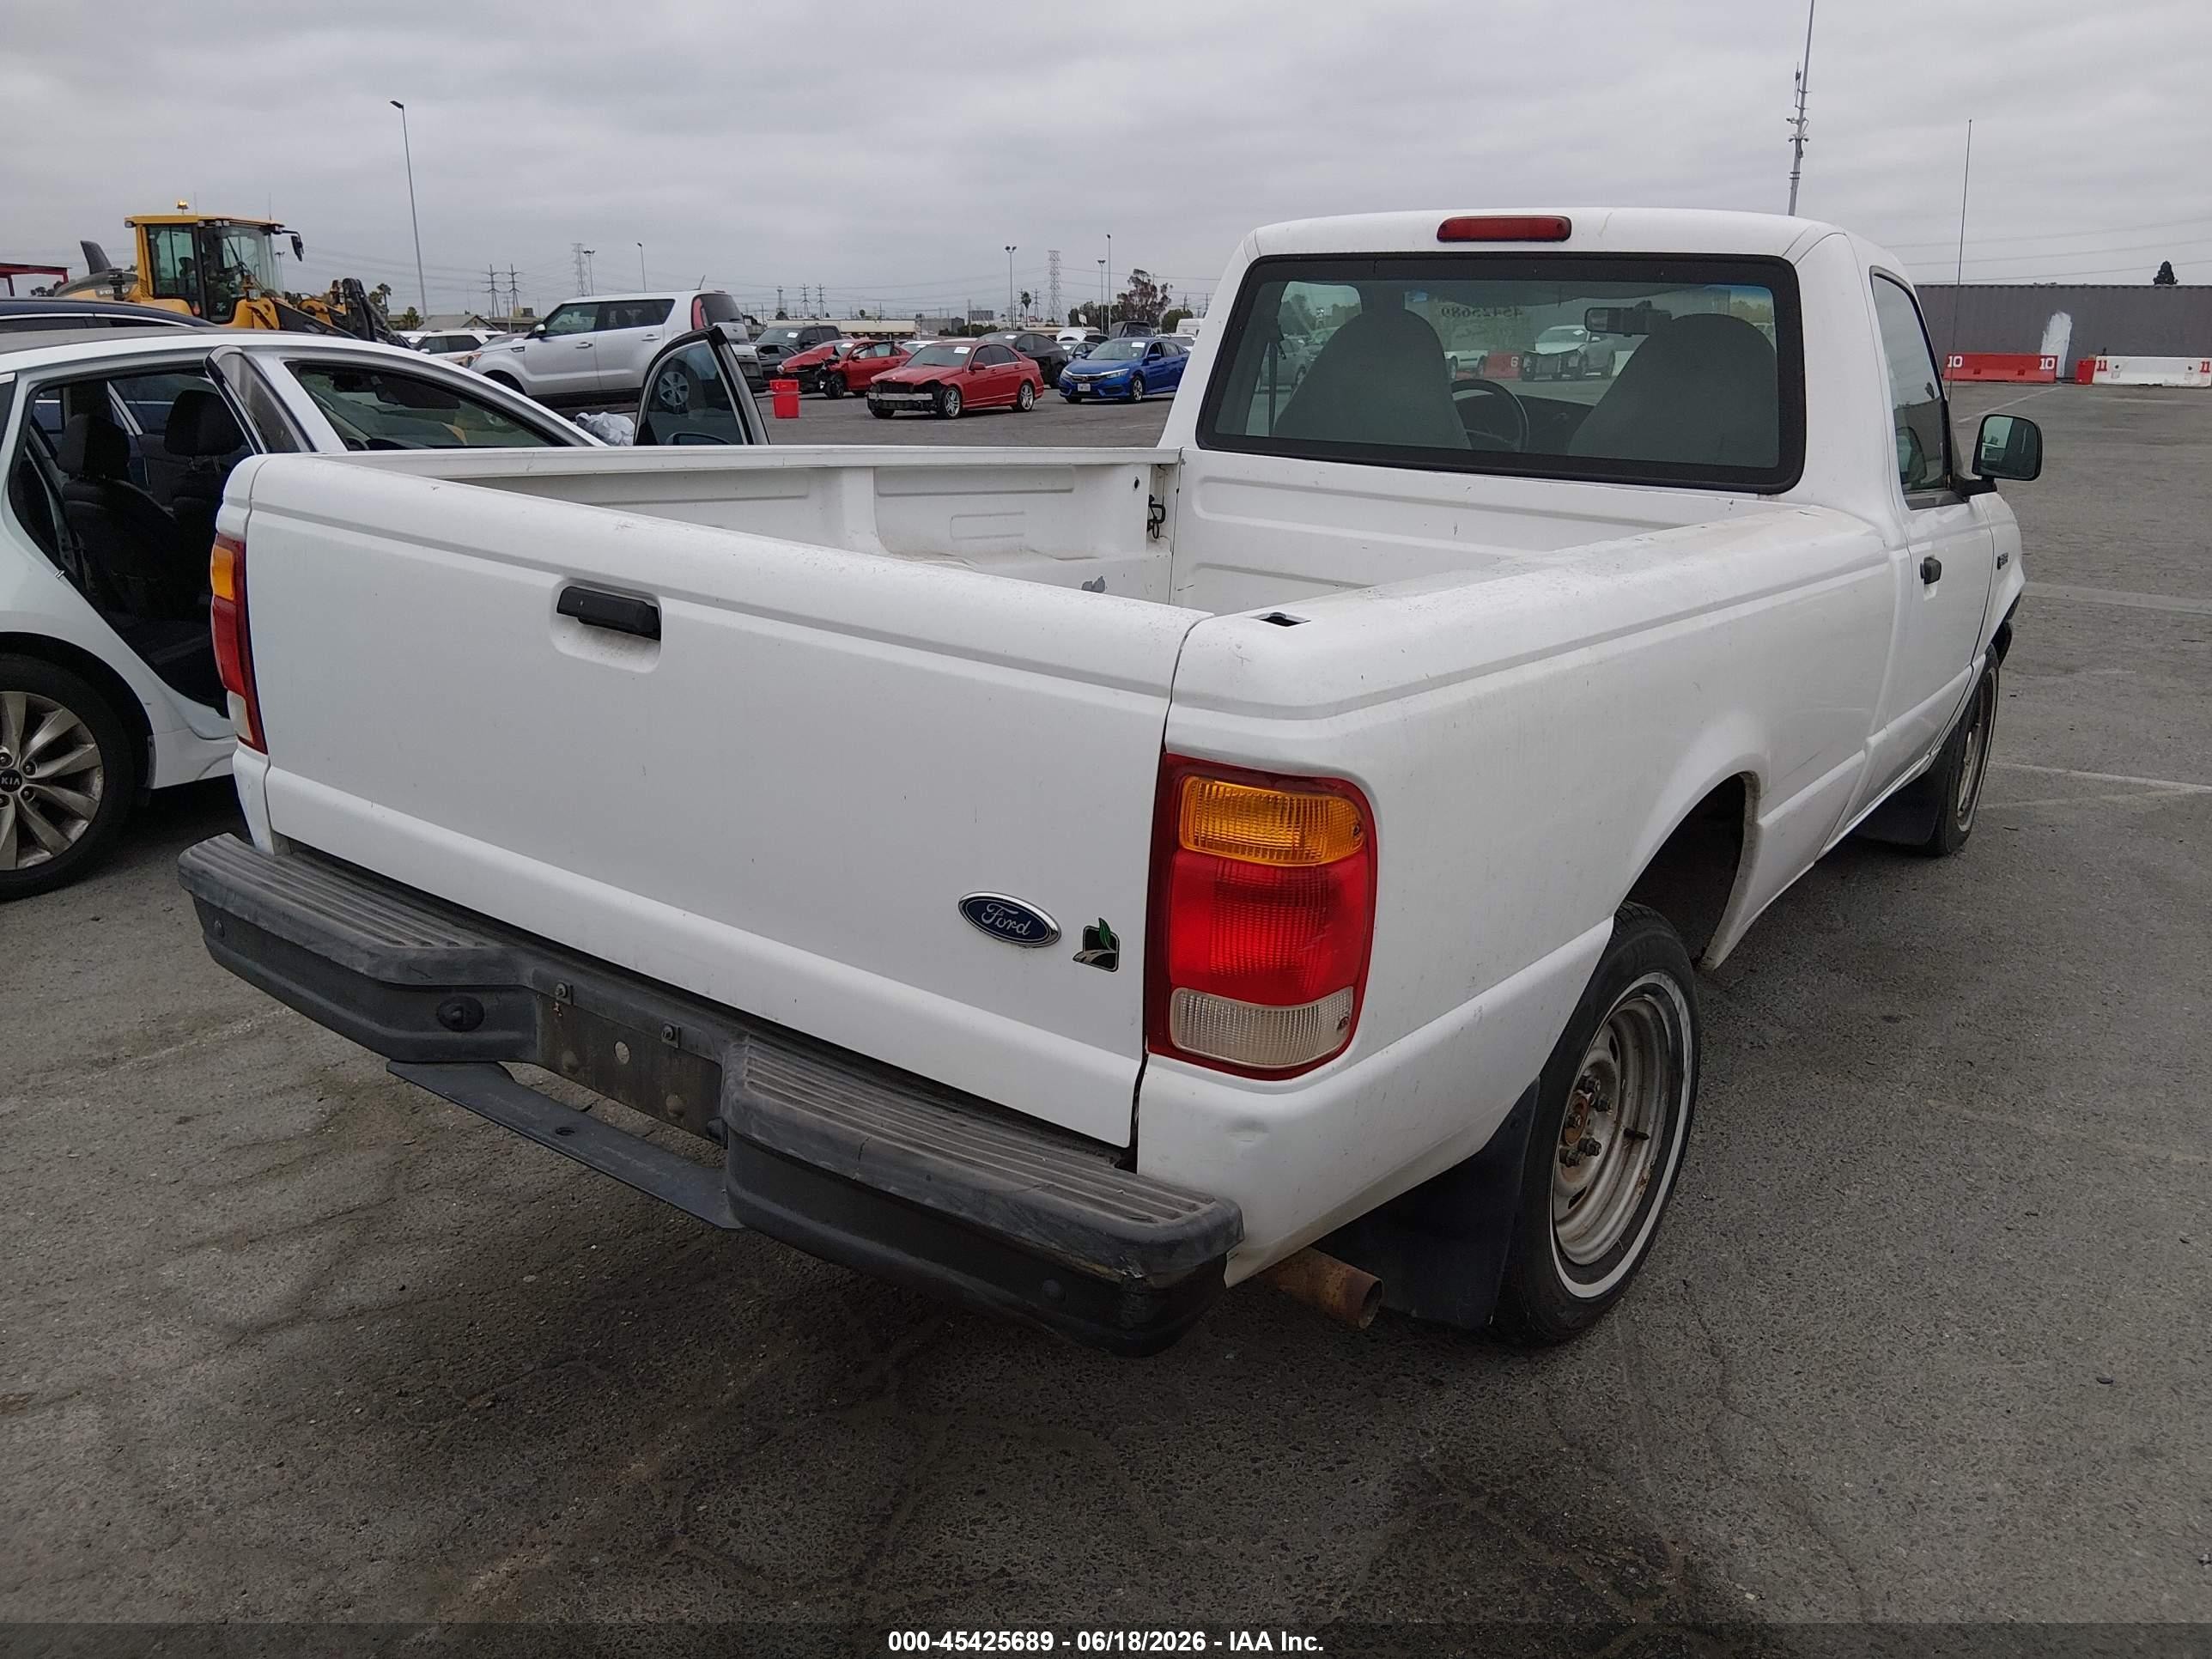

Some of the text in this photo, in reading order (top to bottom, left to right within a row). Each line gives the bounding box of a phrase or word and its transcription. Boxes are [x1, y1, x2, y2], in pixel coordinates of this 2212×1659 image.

[1947, 356, 1963, 368] 10
[2039, 357, 2055, 370] 10
[2096, 360, 2107, 372] 11
[2200, 362, 2210, 373] 11
[1, 776, 21, 786] KIA
[981, 902, 1031, 936] Ford
